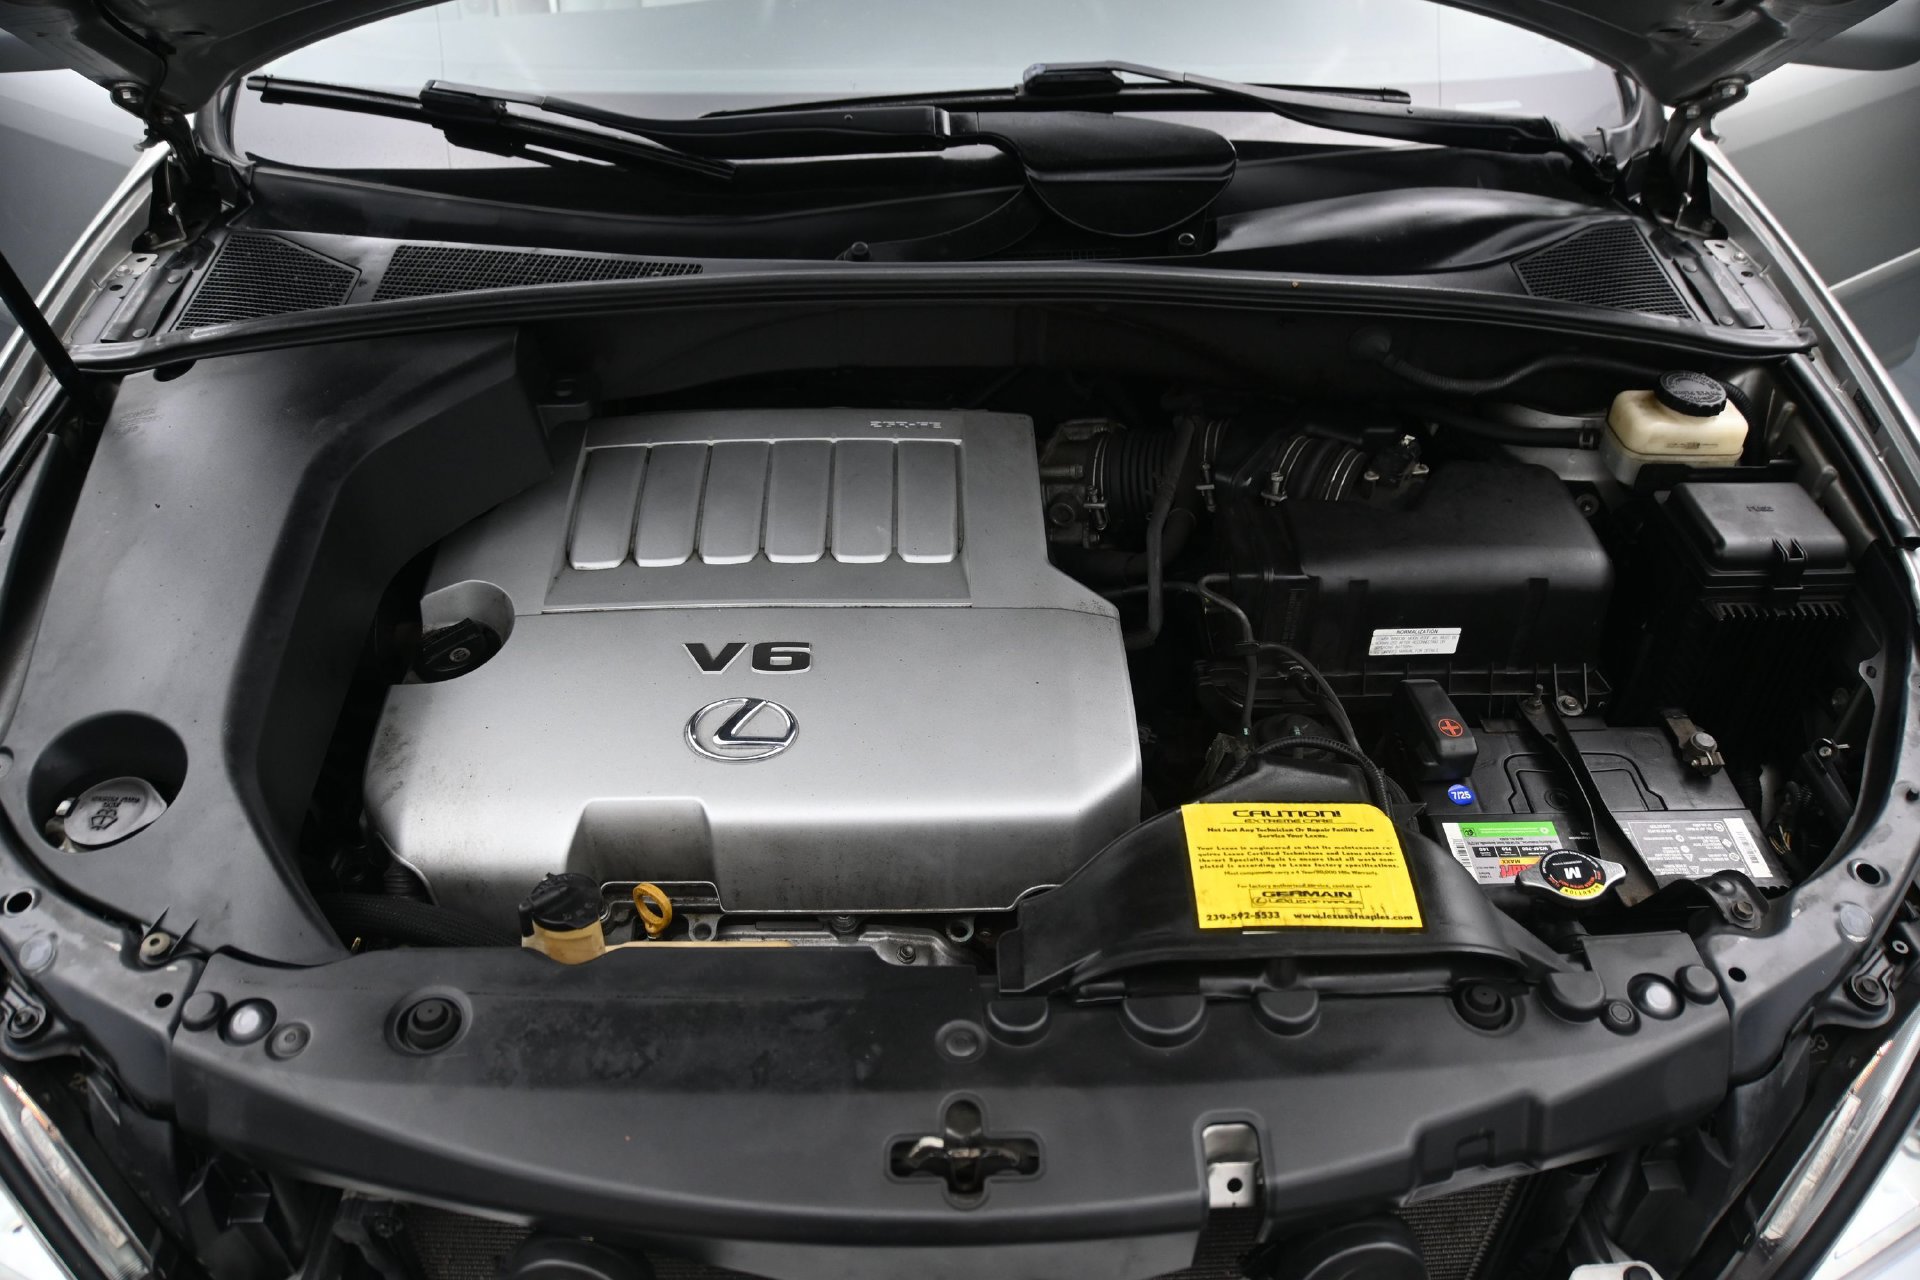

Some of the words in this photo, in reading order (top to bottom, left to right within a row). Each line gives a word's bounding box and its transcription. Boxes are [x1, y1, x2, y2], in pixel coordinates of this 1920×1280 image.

[682, 642, 812, 674] V6
[1451, 790, 1472, 800] 7/25
[1232, 809, 1342, 818] CAUTION!
[1261, 890, 1353, 898] GERMAIN
[1563, 887, 1596, 897] CAUTION
